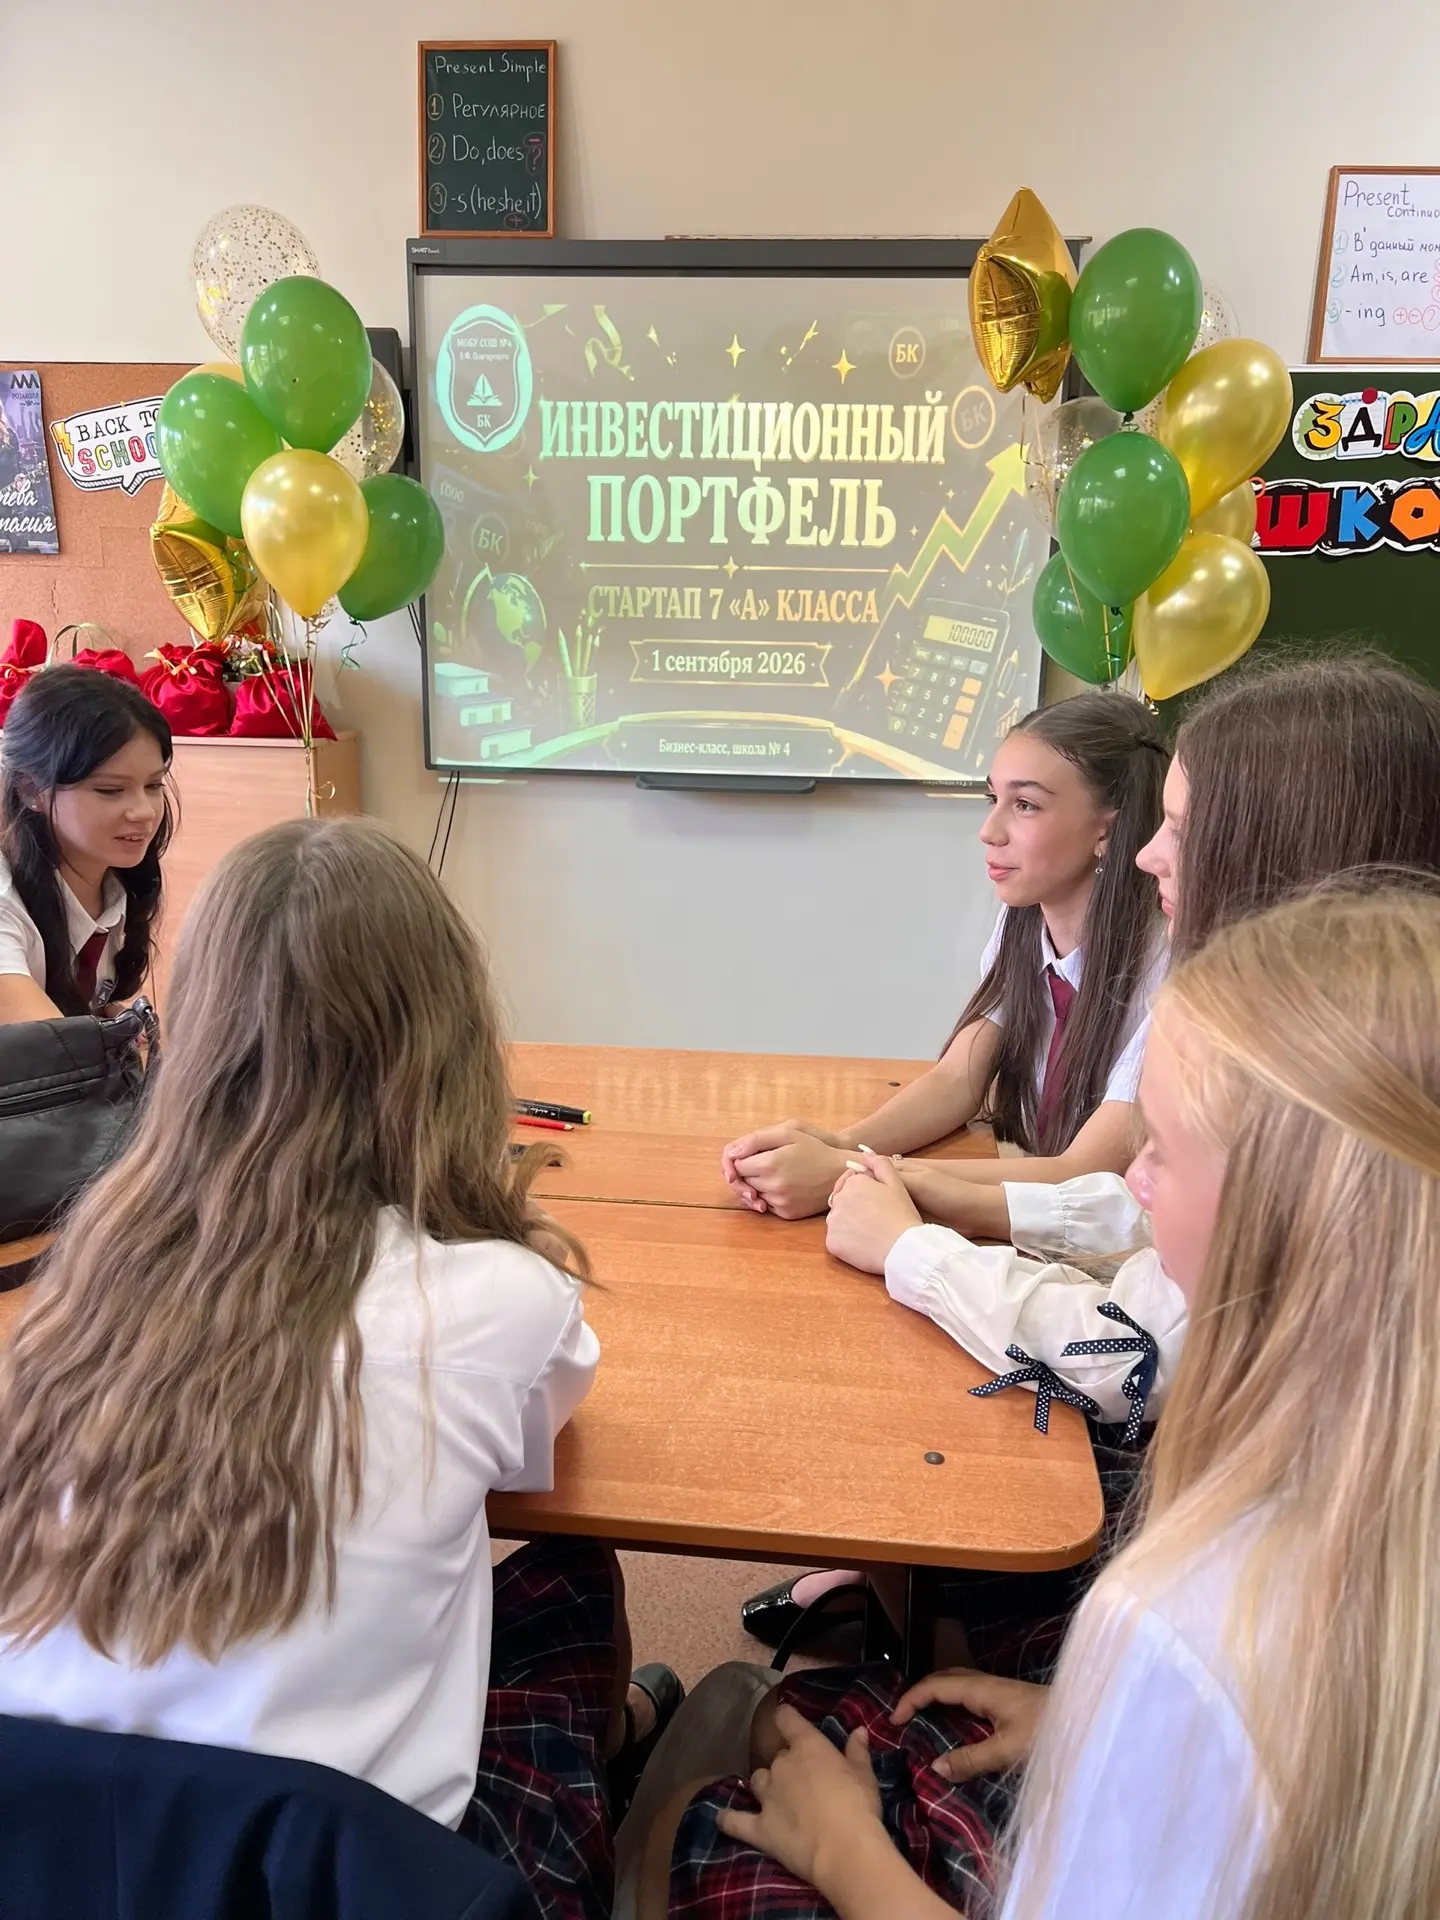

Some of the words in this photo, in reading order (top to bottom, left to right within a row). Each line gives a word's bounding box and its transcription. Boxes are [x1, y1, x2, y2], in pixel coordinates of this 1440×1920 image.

[434, 55, 495, 74] Present
[500, 52, 546, 82] Simple
[1344, 180, 1410, 207] Present
[1401, 269, 1429, 284] are
[895, 343, 919, 363] БК
[75, 415, 132, 442] BACK
[476, 414, 492, 428] БК
[540, 390, 948, 471] ИНВЕСТИЦИОННЫЙ
[586, 474, 896, 547] ПОРТФЕЛЬ
[1255, 486, 1440, 549] ШКО
[477, 527, 503, 555] БК
[588, 584, 702, 620] СТАРТАП
[709, 588, 724, 620] 7
[729, 588, 770, 621] «А»
[775, 588, 880, 623] КЛАССА
[948, 624, 995, 649] 100000
[652, 650, 661, 671] 1
[665, 650, 752, 678] сентября
[757, 651, 806, 675] 2026
[659, 738, 731, 756] Бизнес-класс,
[732, 744, 767, 756] школа
[783, 742, 790, 756] 4
